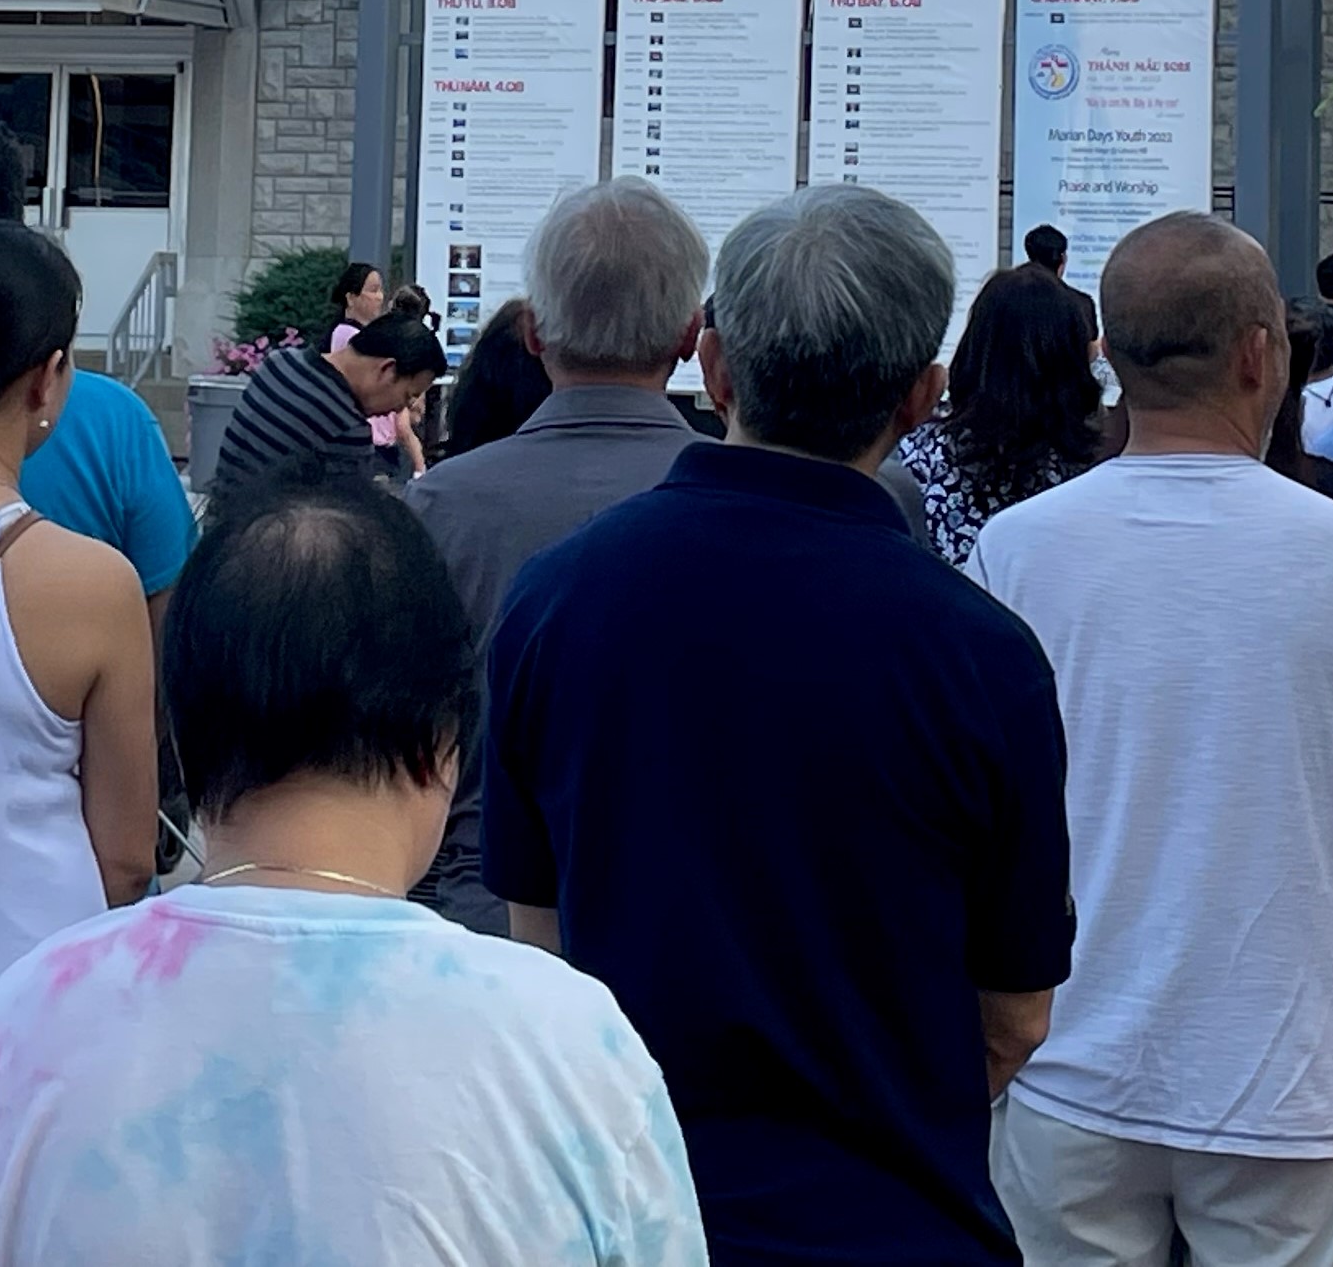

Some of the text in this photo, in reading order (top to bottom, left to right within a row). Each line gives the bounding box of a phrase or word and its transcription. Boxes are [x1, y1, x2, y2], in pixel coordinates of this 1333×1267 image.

[1086, 128, 1115, 145] Days
[1114, 128, 1147, 142] Youth
[1091, 180, 1114, 193] and
